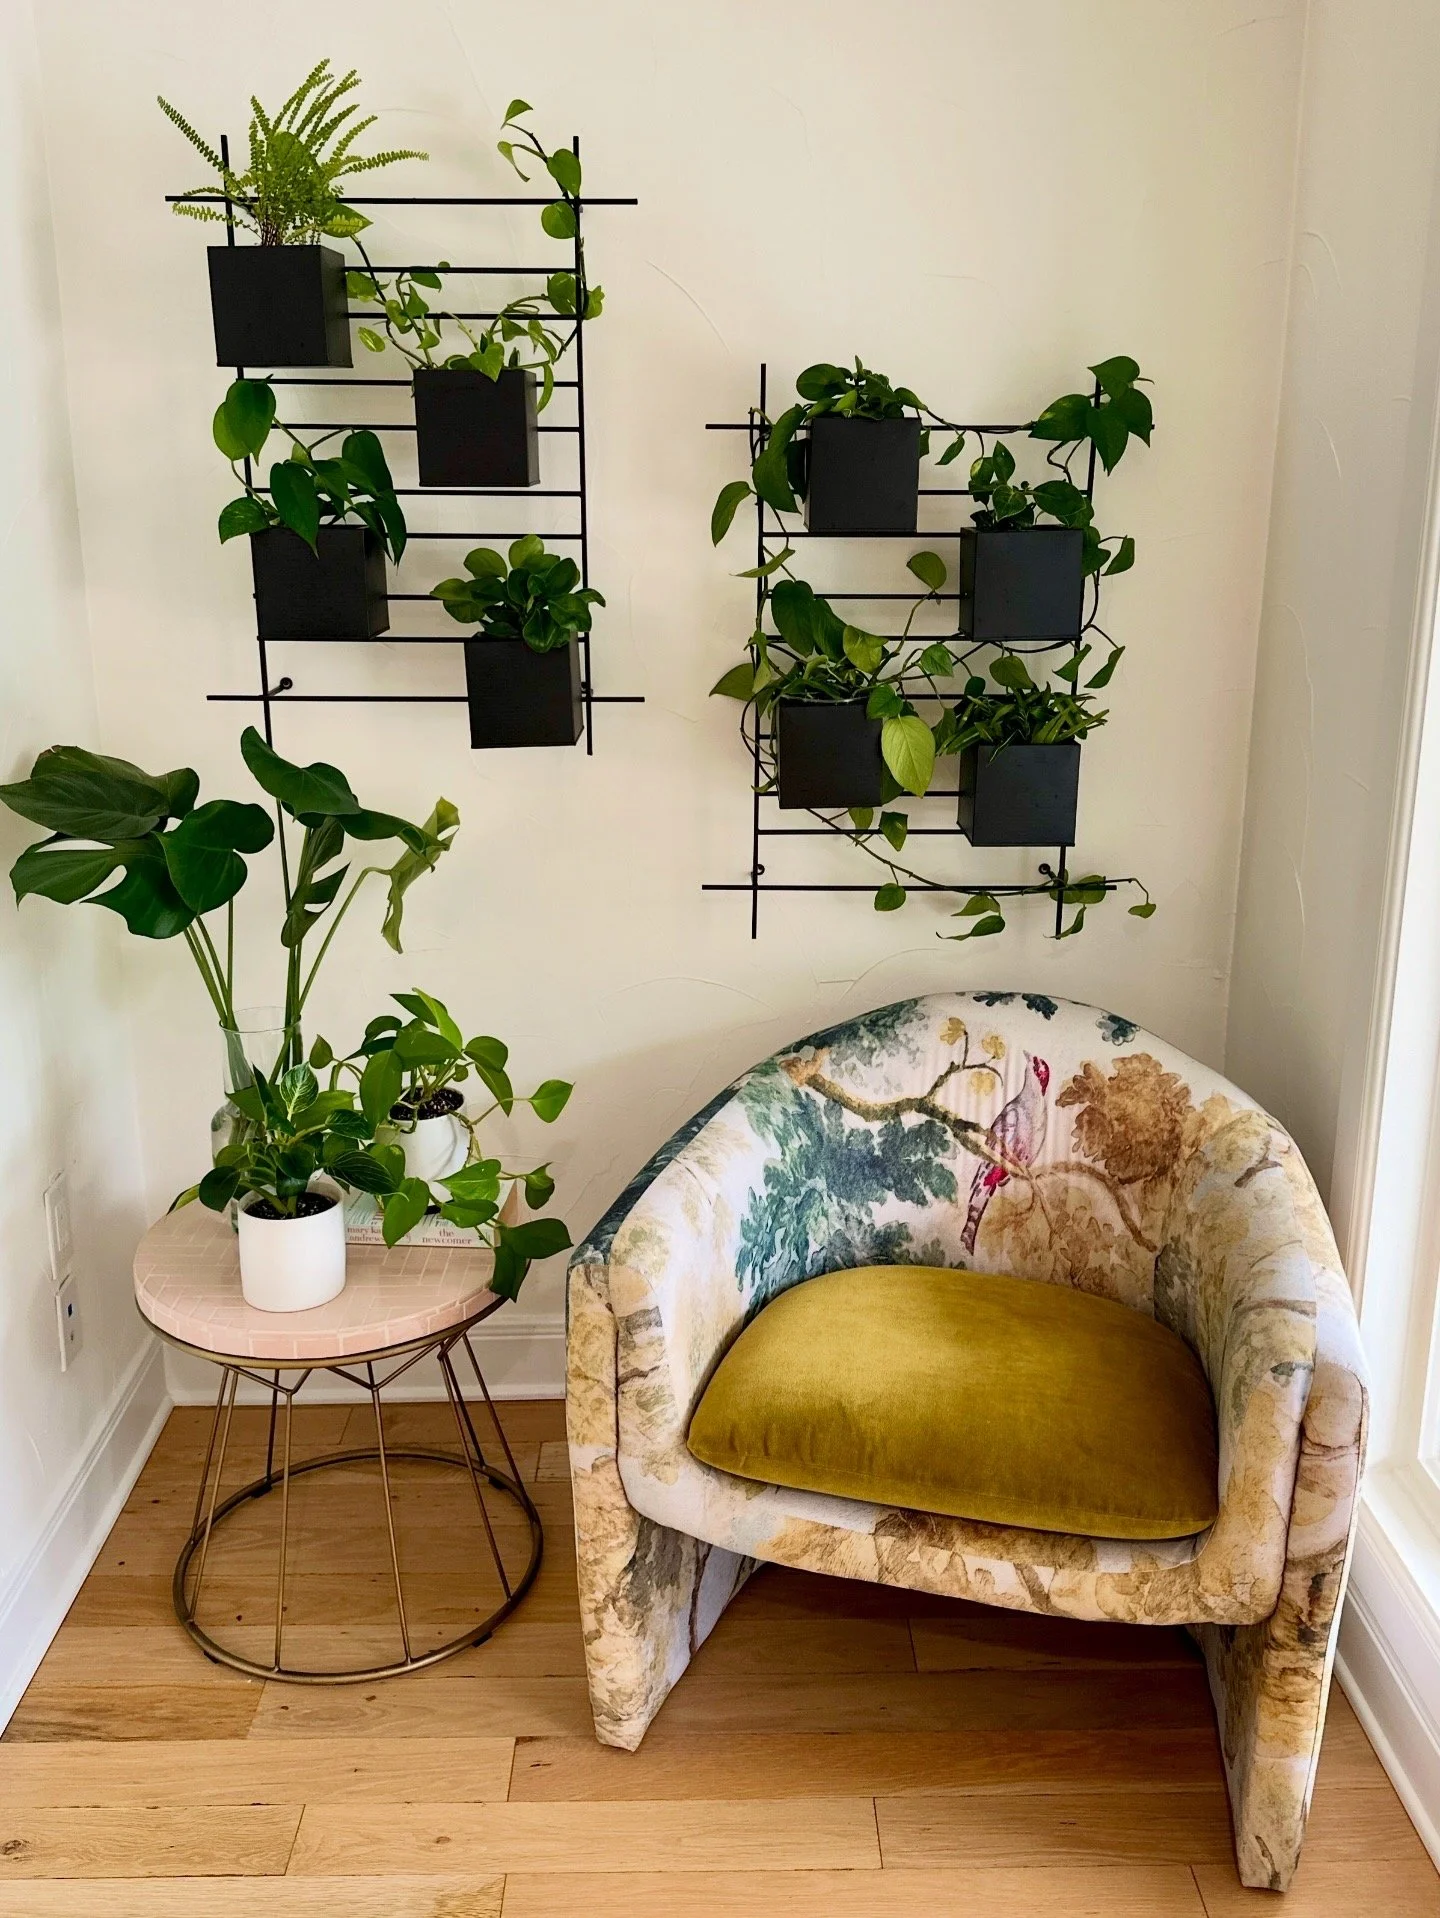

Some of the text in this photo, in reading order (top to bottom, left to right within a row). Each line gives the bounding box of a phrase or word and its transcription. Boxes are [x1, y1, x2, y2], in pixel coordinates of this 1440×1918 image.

[347, 1226, 382, 1235] mary ka
[439, 1228, 455, 1237] the
[422, 1237, 472, 1245] newcomer
